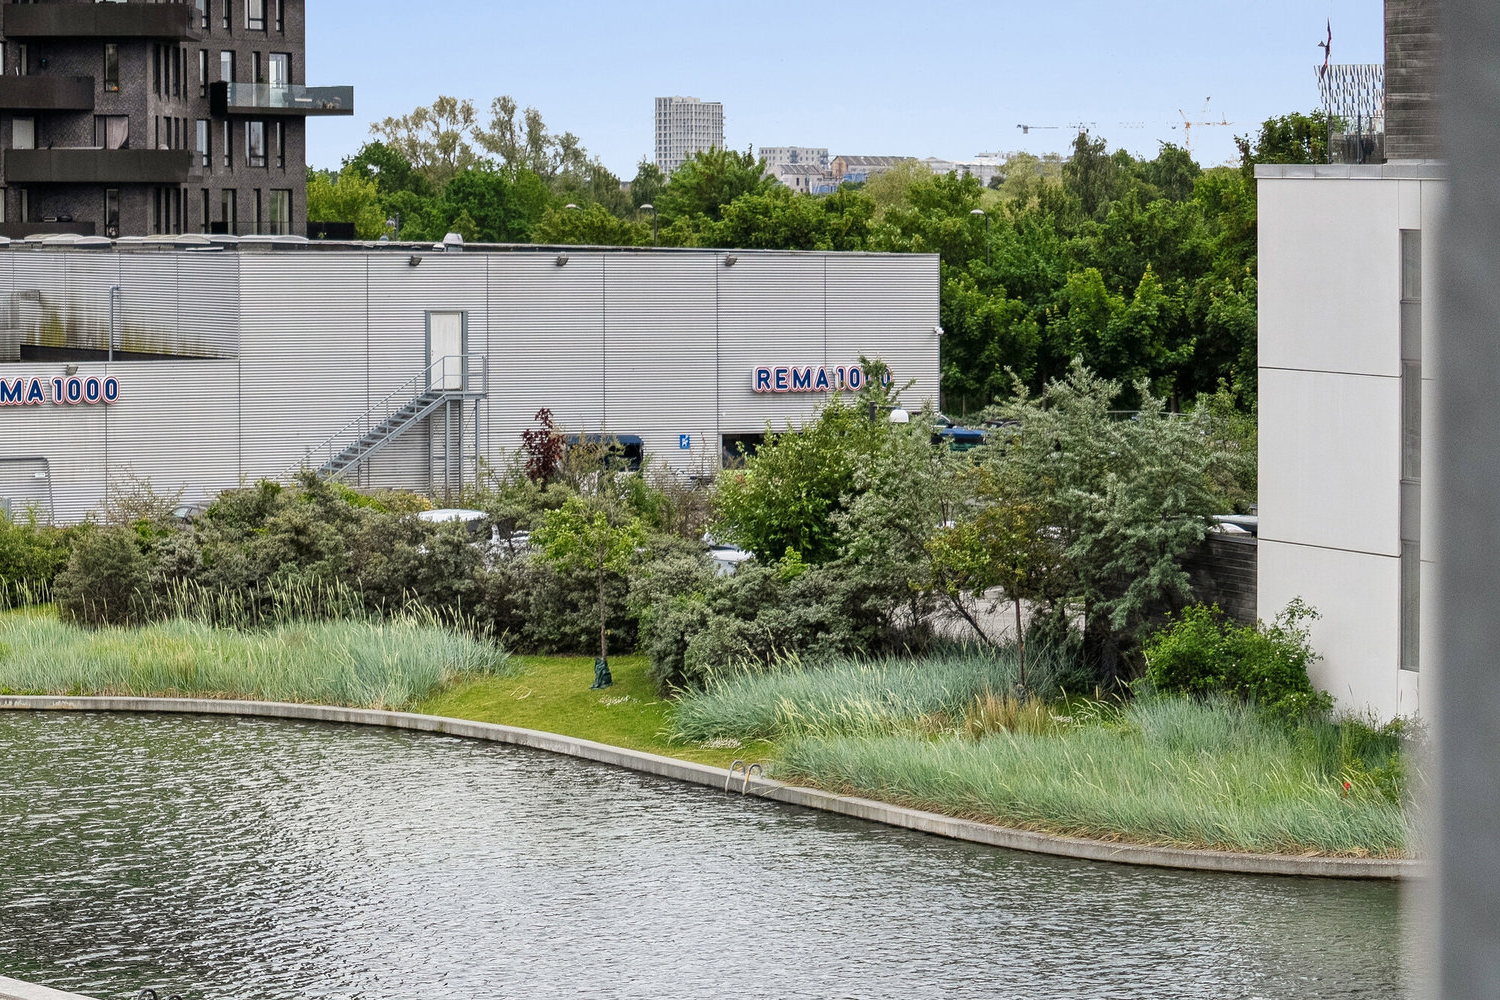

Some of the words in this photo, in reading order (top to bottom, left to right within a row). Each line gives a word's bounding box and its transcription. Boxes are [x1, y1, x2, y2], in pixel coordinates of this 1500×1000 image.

[51, 377, 119, 403] 1000
[756, 368, 830, 391] REMA
[837, 367, 891, 389] 100
